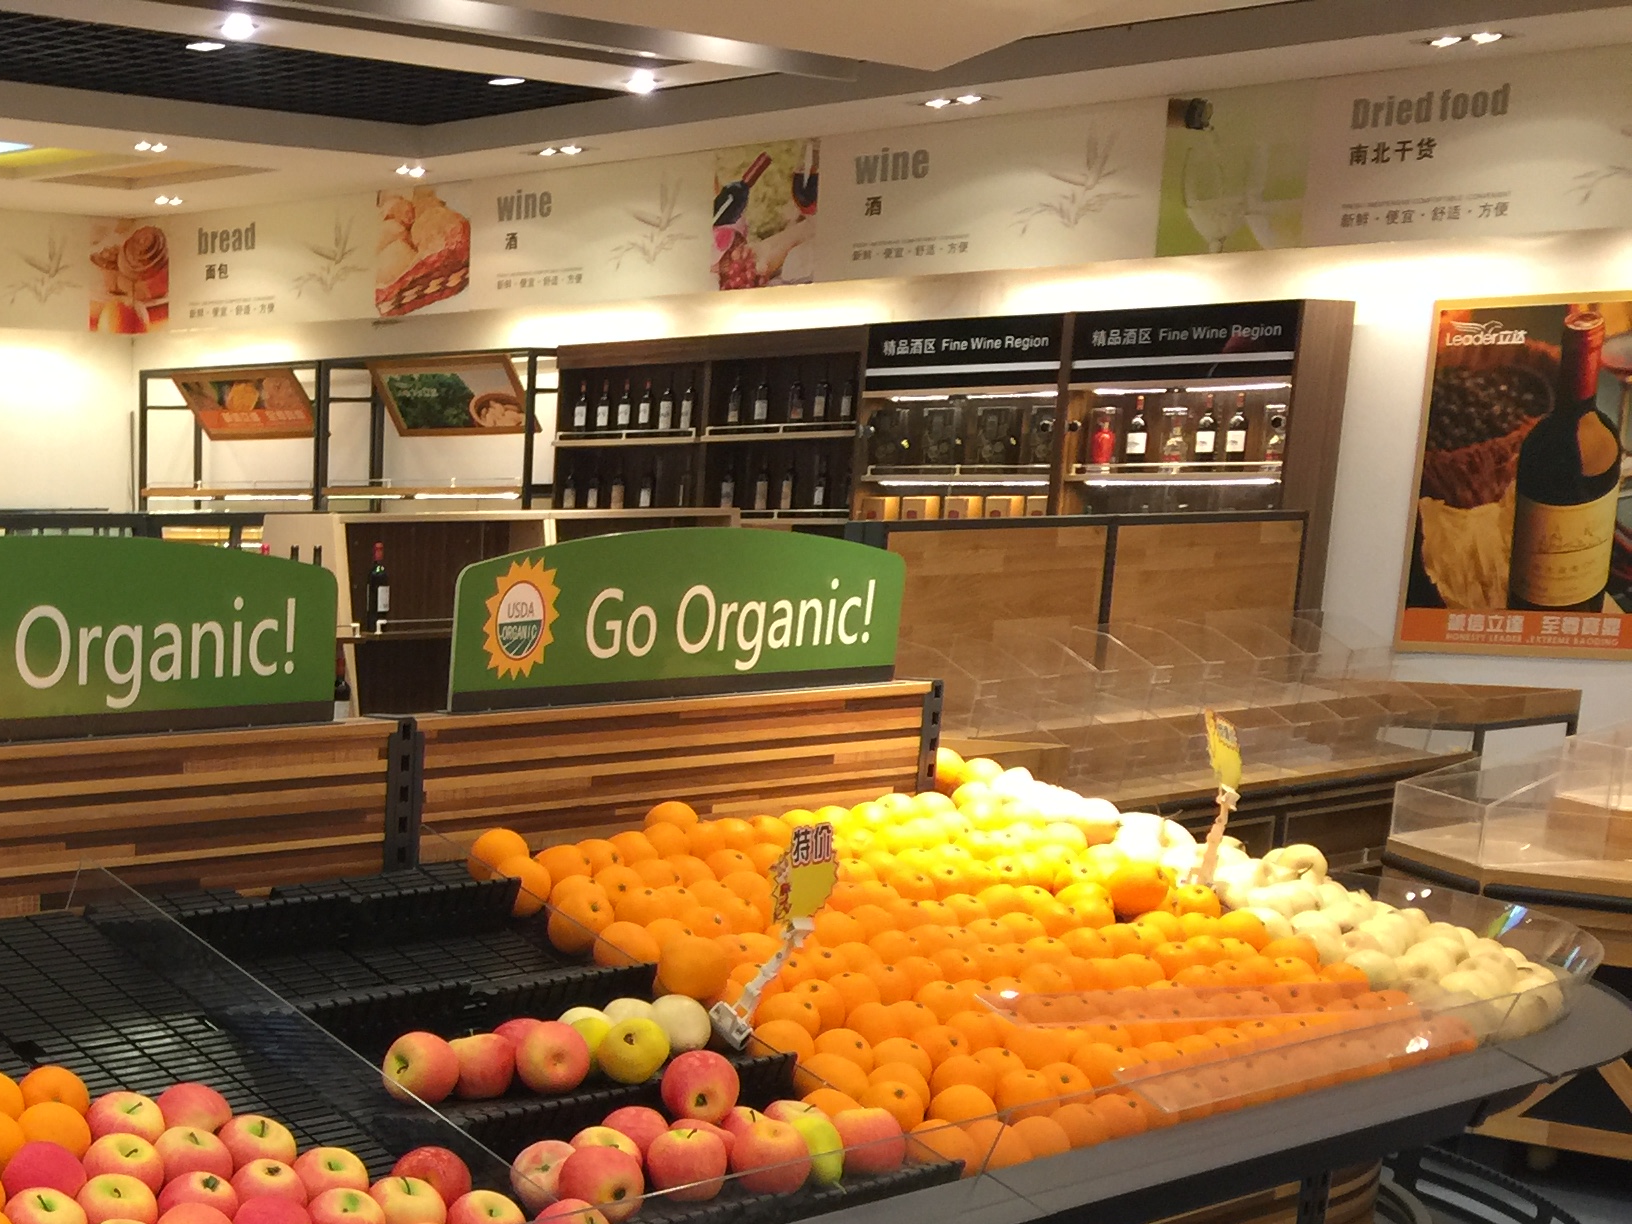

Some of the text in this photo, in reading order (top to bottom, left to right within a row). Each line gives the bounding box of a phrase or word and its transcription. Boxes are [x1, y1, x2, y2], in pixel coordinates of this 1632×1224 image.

[1350, 82, 1511, 130] Dried food
[854, 147, 930, 185] wine
[1349, 136, 1438, 166] 南北干货
[496, 189, 552, 222] wine
[864, 195, 883, 216] 酒
[197, 221, 256, 256] bread
[504, 232, 518, 251] 酒
[205, 263, 229, 281] 面包
[883, 335, 1050, 356] 精品酒区 Fine Wine Region
[1092, 323, 1282, 347] 精品酒区 Fine Wine Region
[507, 601, 535, 619] USDA
[585, 577, 876, 672] Go Organic!
[500, 624, 538, 641] ORGANIC
[15, 596, 297, 708] Organic!
[792, 825, 832, 863] 特价
